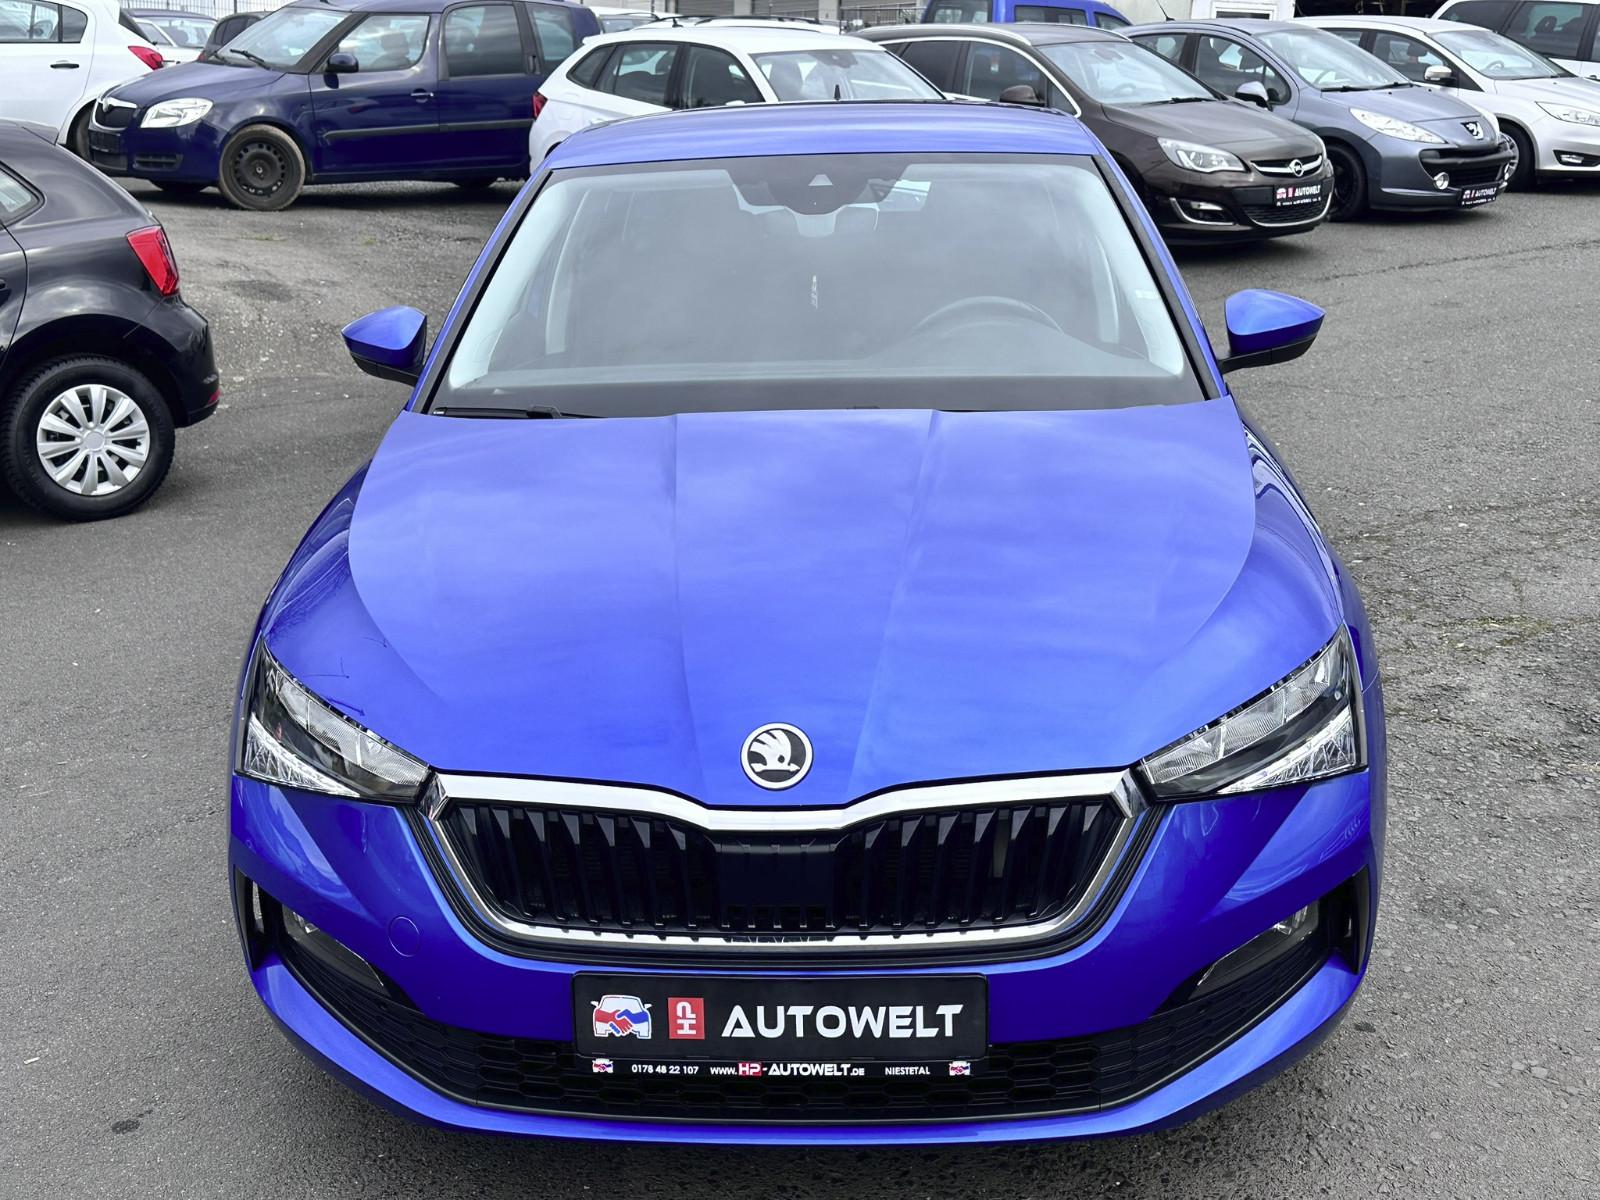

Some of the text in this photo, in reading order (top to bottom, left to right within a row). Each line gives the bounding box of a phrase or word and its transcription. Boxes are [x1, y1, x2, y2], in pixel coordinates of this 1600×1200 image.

[721, 1003, 964, 1039] AUTOWELT
[631, 1063, 654, 1074] 0178
[655, 1064, 667, 1074] 48
[668, 1065, 681, 1075] 22
[682, 1065, 699, 1075] 107
[884, 1066, 931, 1076] NIESTETAL
